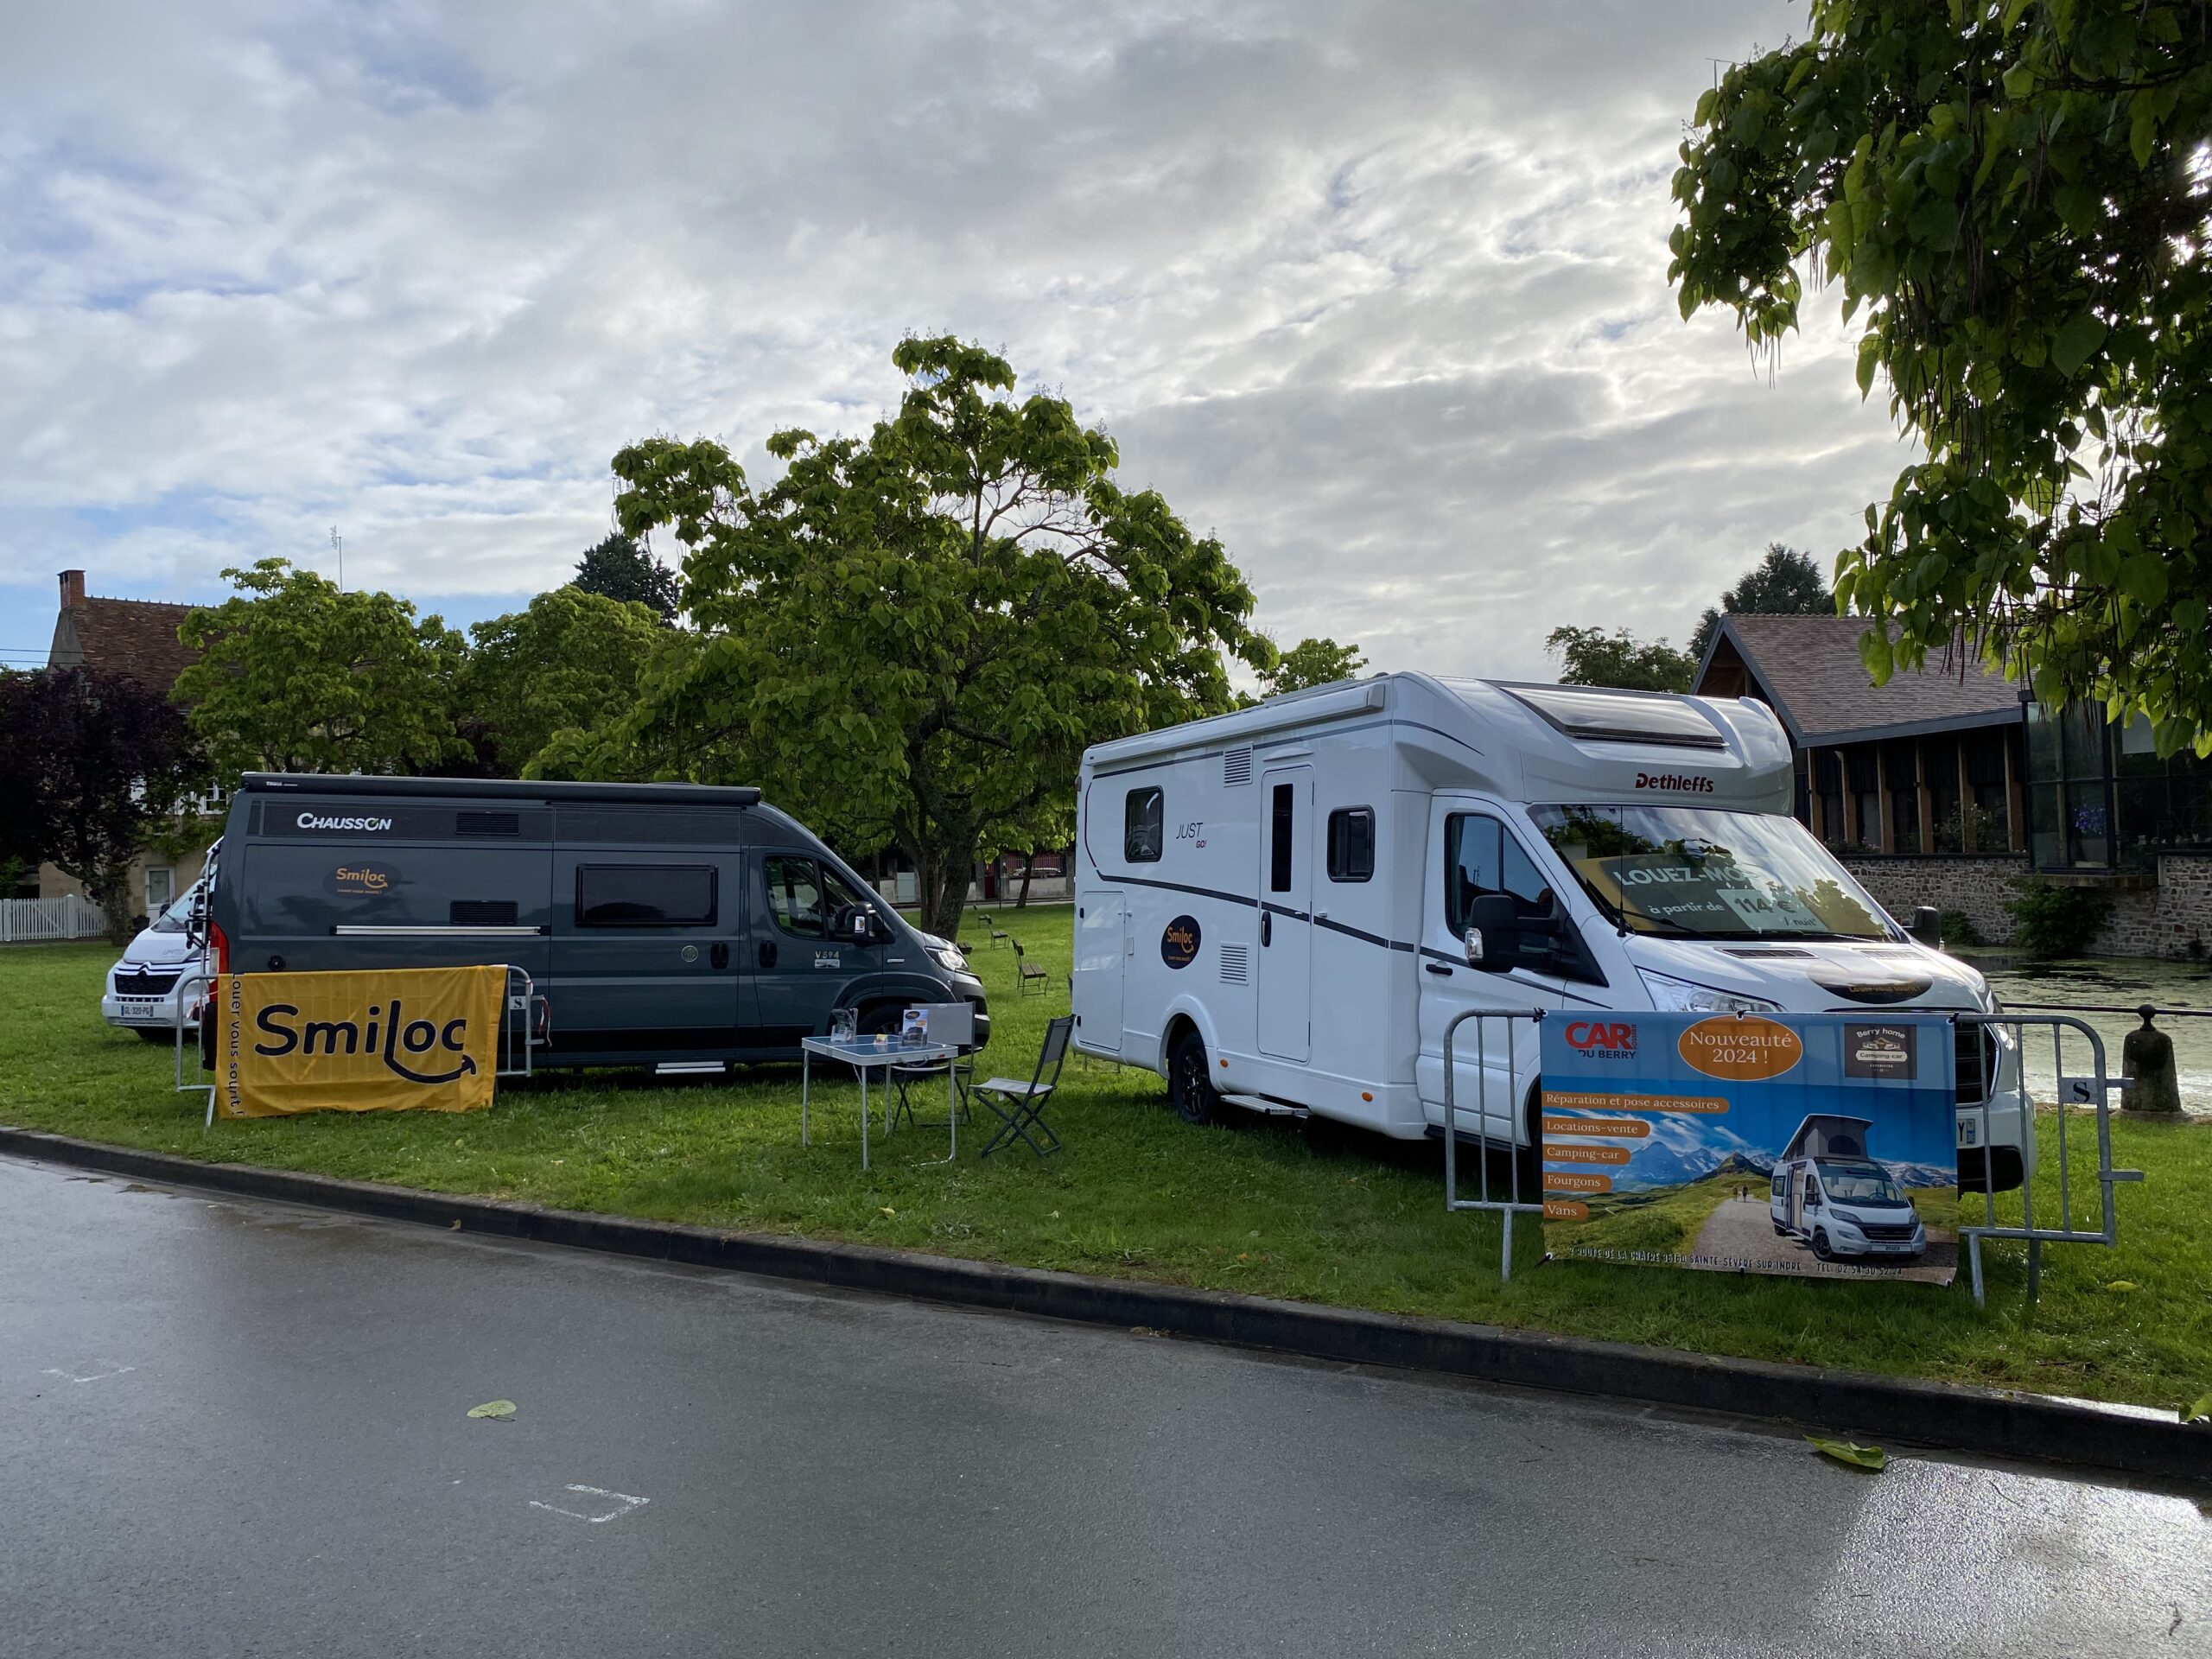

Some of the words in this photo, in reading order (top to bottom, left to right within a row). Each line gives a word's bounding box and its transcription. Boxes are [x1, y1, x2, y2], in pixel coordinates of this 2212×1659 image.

[1636, 772, 1714, 792] Dethleffs
[1176, 822, 1204, 839] JUST
[336, 868, 388, 888] Smiloc
[1613, 867, 1749, 886] LOUEZ-MO
[1649, 902, 1660, 915] à
[1663, 901, 1702, 916] partir
[1707, 900, 1725, 912] de
[1733, 897, 1772, 914] 114
[1780, 899, 1797, 914] €
[1167, 926, 1195, 954] Smiloc
[514, 997, 523, 1009] S
[230, 1020, 240, 1058] vous
[1565, 1022, 1633, 1050] CAR
[1689, 1031, 1792, 1048] Nouveauté
[1856, 1028, 1880, 1038] Berry
[1882, 1027, 1906, 1039] home
[255, 1000, 476, 1084] Smiloc
[1598, 1050, 1637, 1059] BERRY
[1713, 1048, 1758, 1064] 2024
[228, 1062, 242, 1107] sourit
[2072, 1082, 2091, 1103] S
[1546, 1093, 1607, 1106] Réparation
[1609, 1096, 1621, 1106] et
[1624, 1097, 1650, 1109] pose
[1653, 1100, 1720, 1110] accessoires
[1547, 1121, 1638, 1135] Locations-vente
[1547, 1147, 1620, 1161] Camping-car
[1548, 1174, 1601, 1189] Fourgons
[1548, 1205, 1577, 1217] Vans
[1757, 1260, 1773, 1269] SUR
[1776, 1262, 1801, 1271] INDRE
